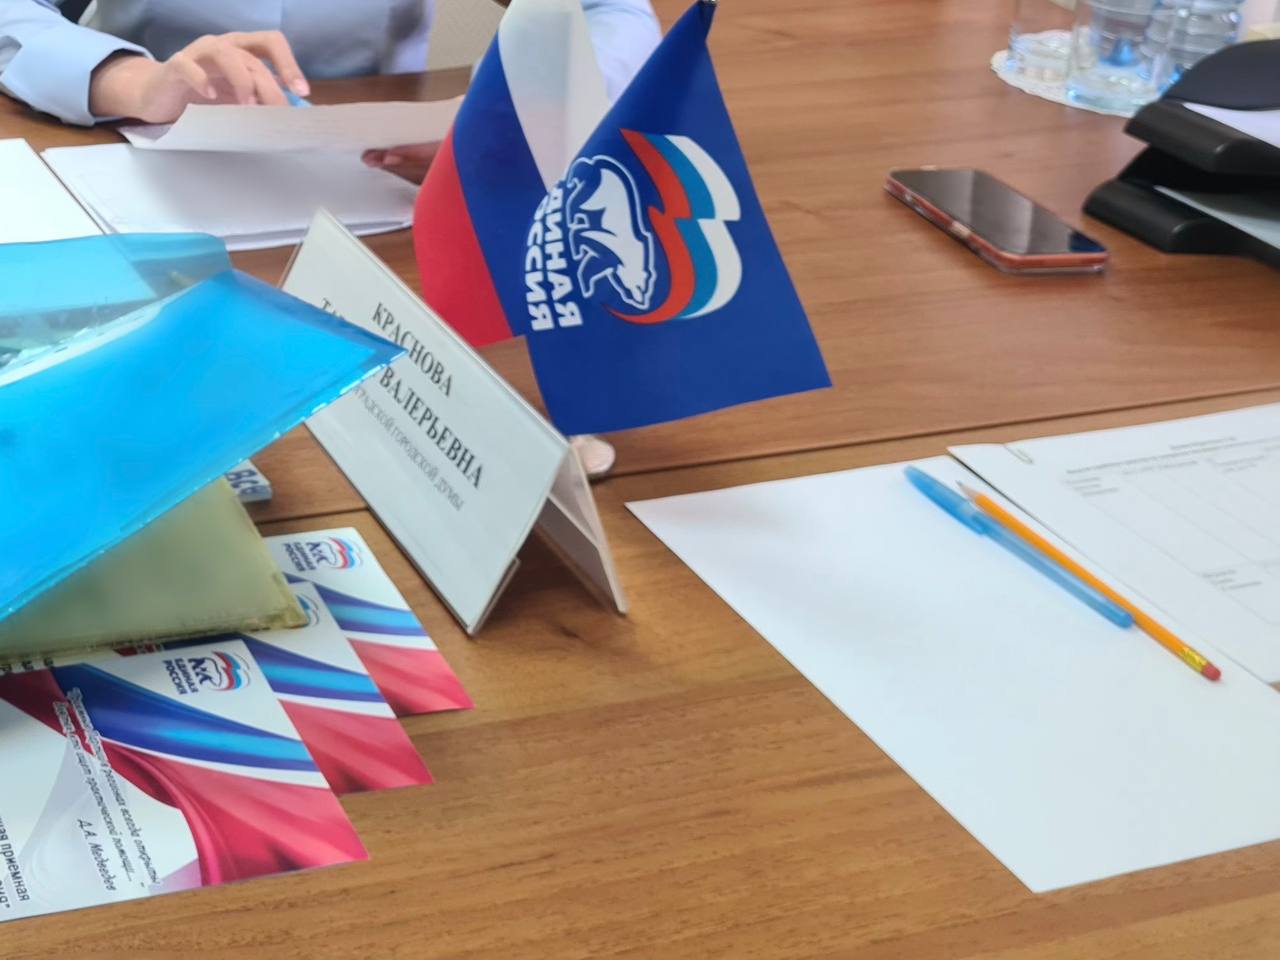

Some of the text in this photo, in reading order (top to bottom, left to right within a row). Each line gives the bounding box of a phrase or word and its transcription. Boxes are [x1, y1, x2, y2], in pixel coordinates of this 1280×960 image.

[544, 188, 583, 327] ДИНАЯ
[372, 302, 452, 396] КРАСНОВА
[379, 366, 483, 489] ВАЛЕРЬЕВНА
[162, 660, 188, 695] РОССИЯ
[0, 842, 30, 902] приемная
